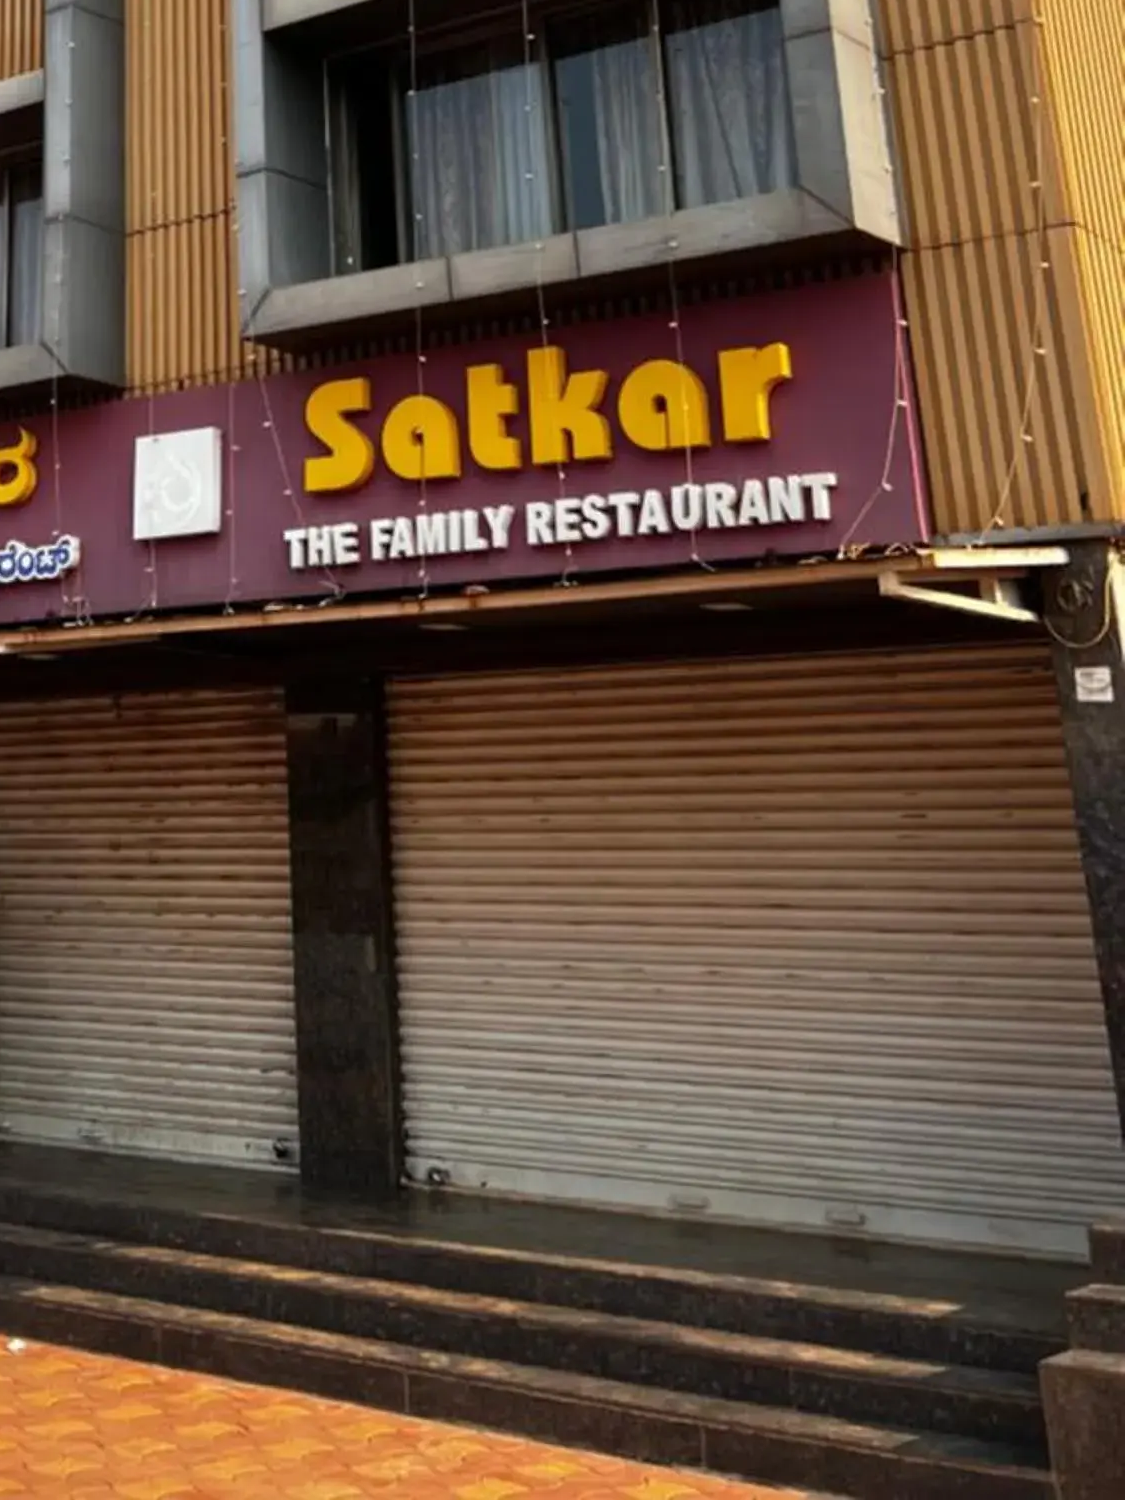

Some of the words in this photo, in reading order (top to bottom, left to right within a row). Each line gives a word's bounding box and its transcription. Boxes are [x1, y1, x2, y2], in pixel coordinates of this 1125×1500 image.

[303, 341, 793, 493] Satkar
[283, 522, 361, 569] THE
[370, 505, 515, 560] FAMILY
[526, 472, 837, 546] RESTAURANT
